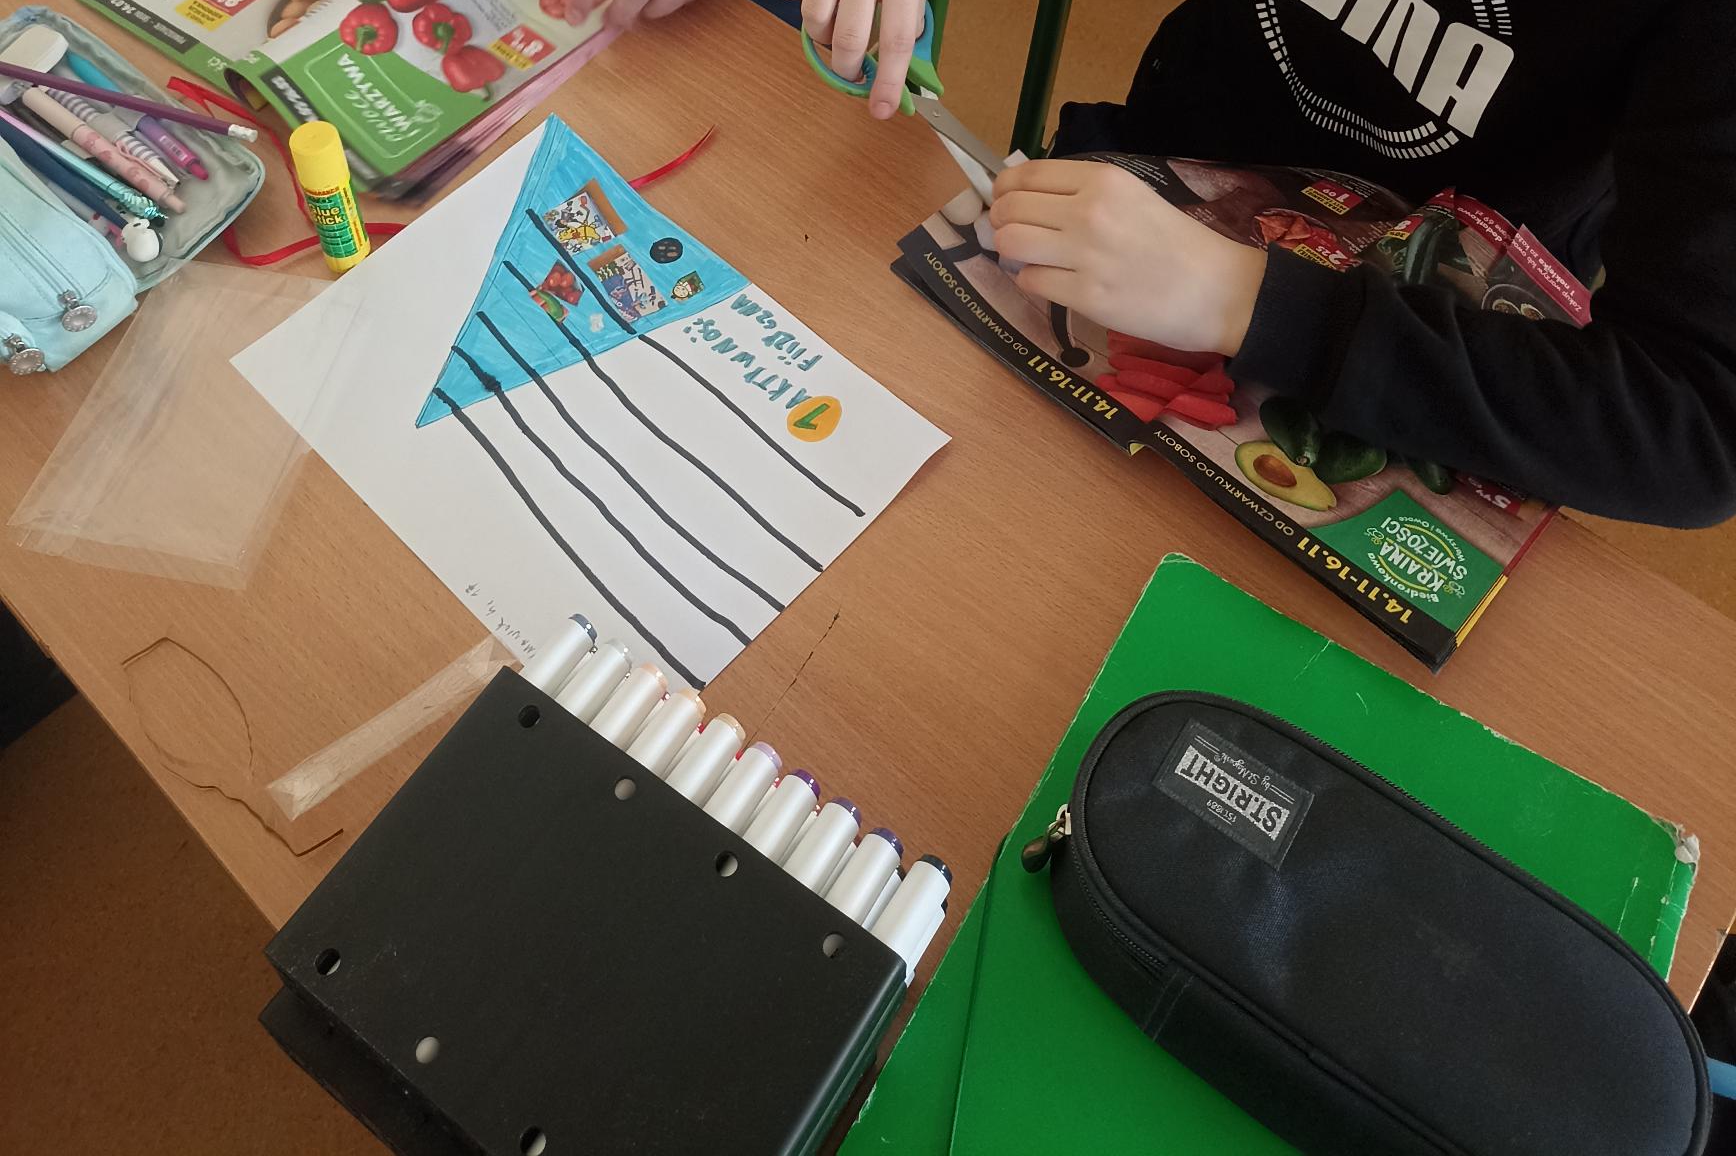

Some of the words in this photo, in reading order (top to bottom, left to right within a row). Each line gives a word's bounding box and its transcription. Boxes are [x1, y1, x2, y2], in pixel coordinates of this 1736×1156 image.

[337, 53, 413, 132] WARZYWA
[924, 252, 957, 288] SOBOTY
[954, 286, 971, 303] DO
[966, 301, 1014, 344] CZWARTKU
[1012, 342, 1029, 356] OD
[1027, 355, 1119, 420] 14.11-16.11
[793, 403, 830, 430] 1
[1154, 430, 1197, 464] SOBOTY
[1196, 461, 1215, 477] DO
[1214, 475, 1274, 521] CZWARTKU
[1275, 520, 1294, 536] OD
[1399, 516, 1430, 528] Owoce
[1380, 517, 1468, 581] ŚWIEŻOŚCI
[1436, 528, 1466, 562] Warzywa
[1297, 536, 1414, 624] 14.11-16.11
[1367, 552, 1439, 603] Biedronkowa
[1379, 541, 1445, 592] KRAINA
[1180, 753, 1282, 833] ST.RIGHT
